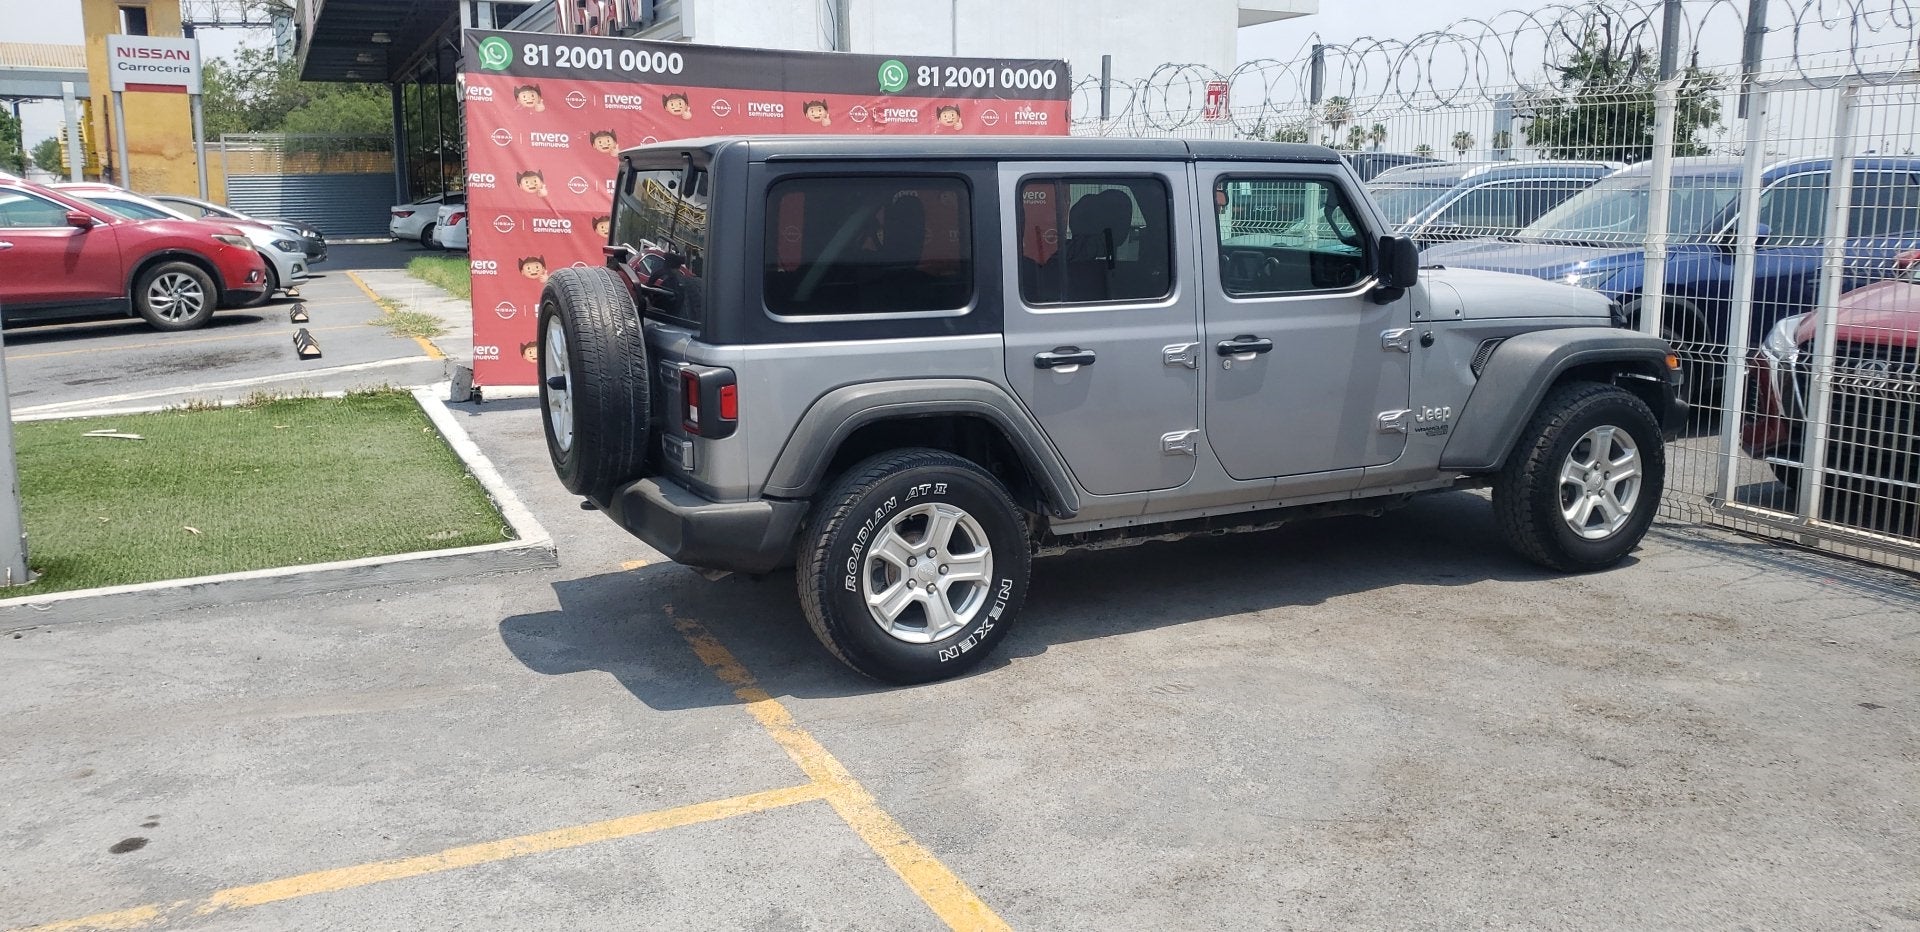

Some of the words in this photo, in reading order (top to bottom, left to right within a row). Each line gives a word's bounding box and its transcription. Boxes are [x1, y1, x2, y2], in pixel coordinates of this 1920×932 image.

[116, 47, 190, 60] NISSAN
[523, 43, 549, 67] 81
[555, 45, 613, 70] 2001
[619, 49, 684, 75] 0000
[117, 61, 191, 73] Carroceria
[917, 65, 939, 88] 81
[945, 66, 995, 89] 2001
[1001, 68, 1057, 90] 0000
[604, 94, 642, 105] rivero
[748, 102, 784, 113] rivero
[884, 108, 918, 118] rivero
[1014, 111, 1048, 121] rivero
[530, 132, 569, 143] rivero
[531, 141, 570, 149] seminuevos
[533, 218, 572, 229] rivero
[1415, 405, 1452, 423] Jeep
[845, 496, 898, 592] ROADIAN
[905, 483, 931, 501] AT
[939, 578, 1013, 662] NEXEN
